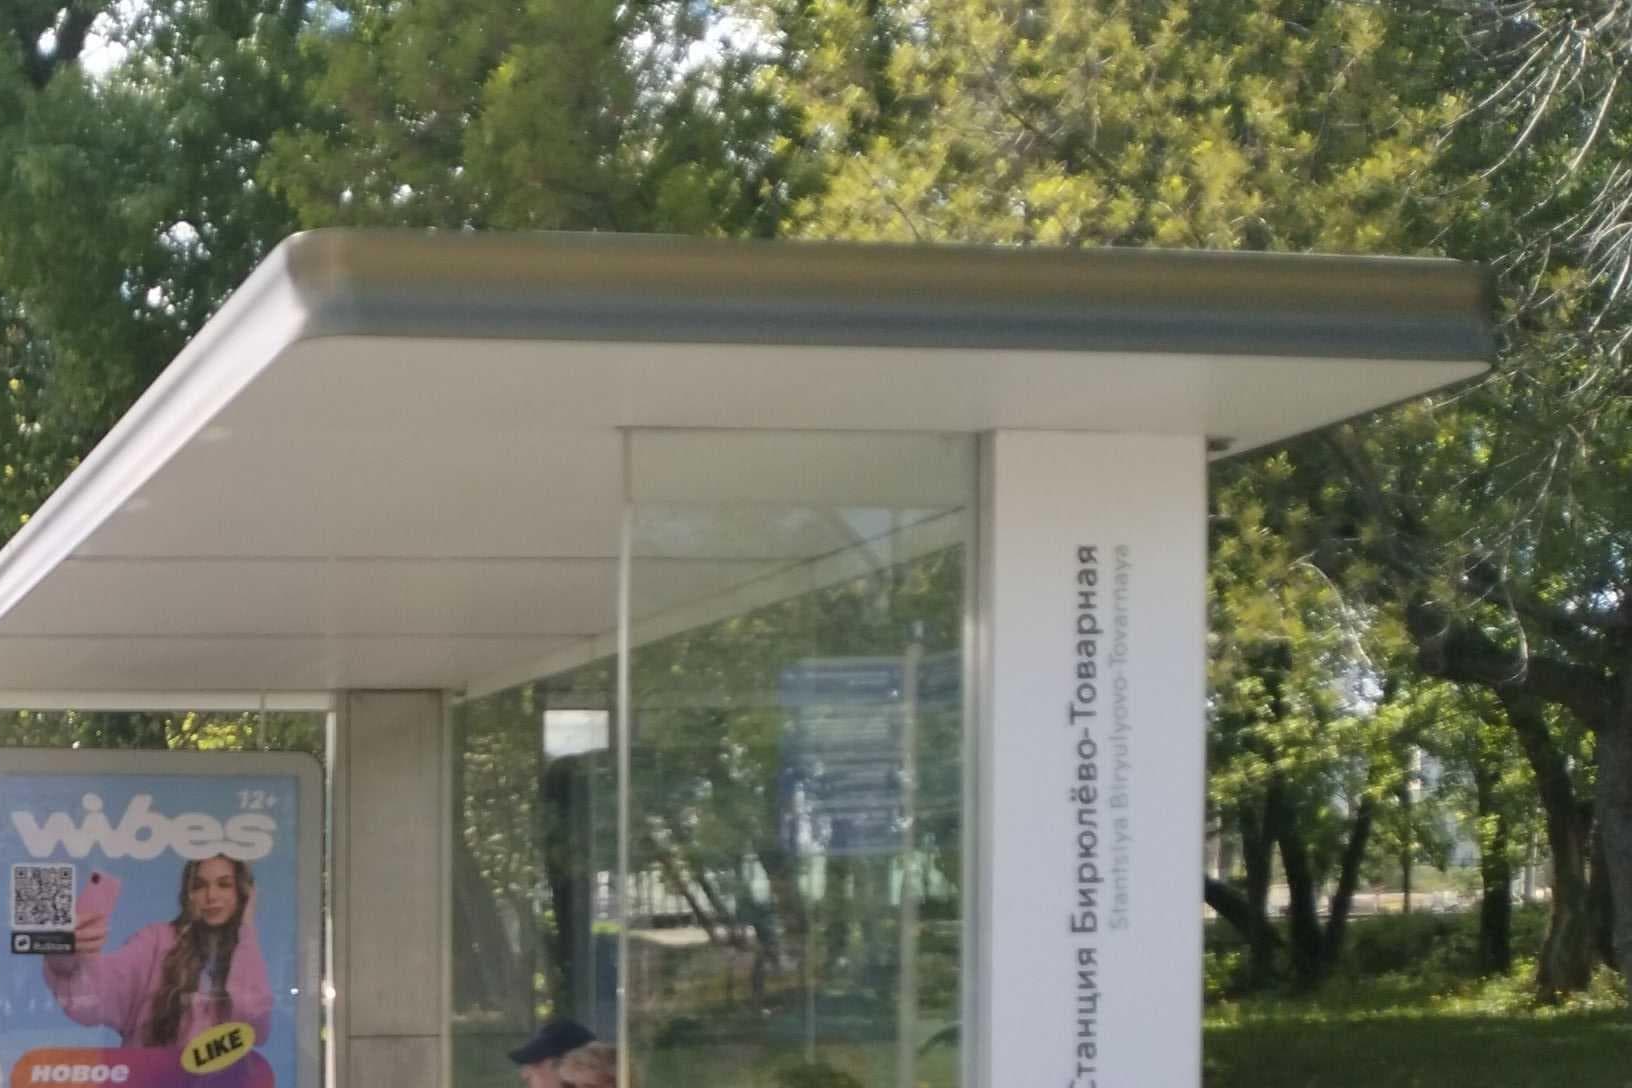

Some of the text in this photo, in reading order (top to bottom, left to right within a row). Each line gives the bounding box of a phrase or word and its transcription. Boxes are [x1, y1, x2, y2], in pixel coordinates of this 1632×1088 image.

[1068, 544, 1105, 933] Бирюлёво-Товарная
[10, 792, 278, 861] wibes
[1109, 817, 1132, 931] Stantsiya
[31, 1064, 129, 1082] новое
[192, 1028, 244, 1068] LIKE
